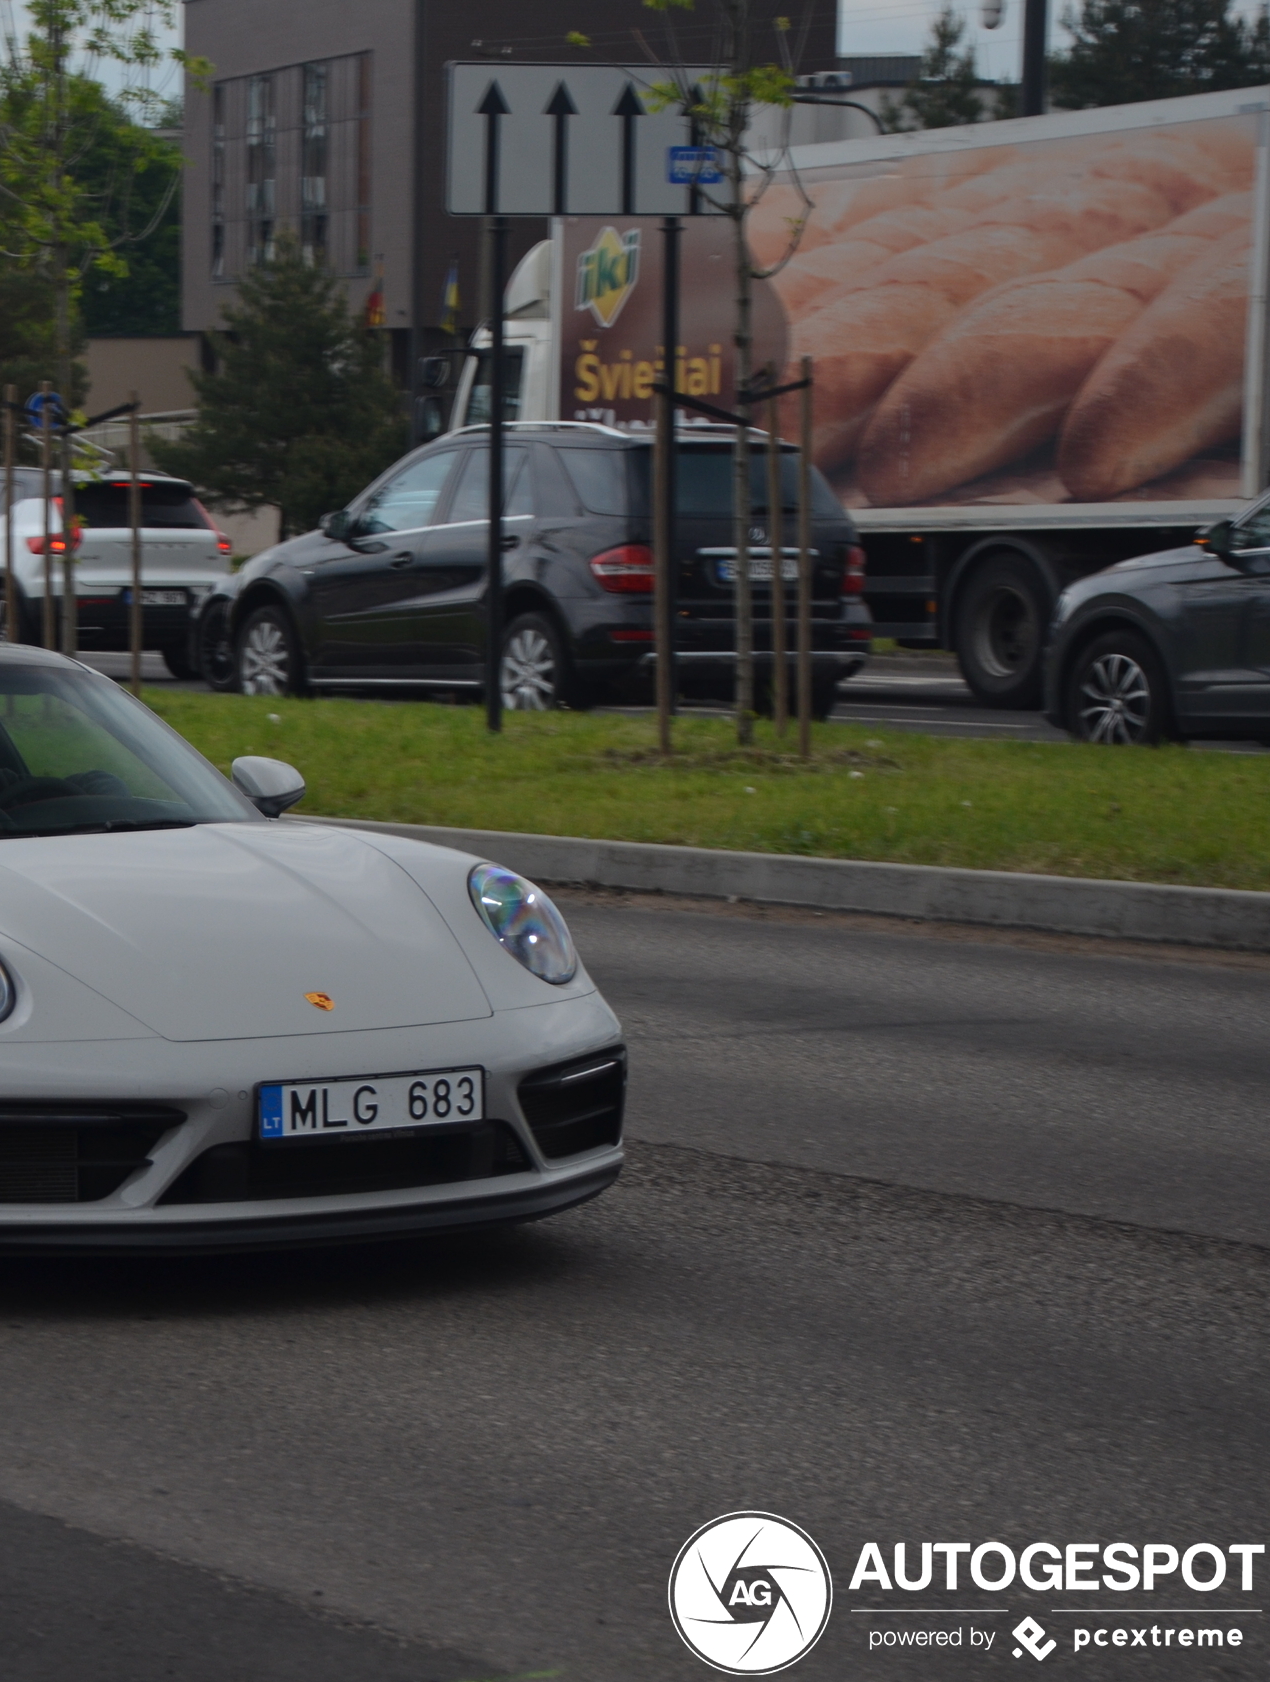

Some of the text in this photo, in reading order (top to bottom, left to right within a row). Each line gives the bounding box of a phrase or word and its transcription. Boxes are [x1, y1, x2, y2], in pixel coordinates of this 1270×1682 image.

[575, 228, 641, 311] iki
[263, 1116, 281, 1130] LT
[291, 1076, 474, 1130] MLG 683
